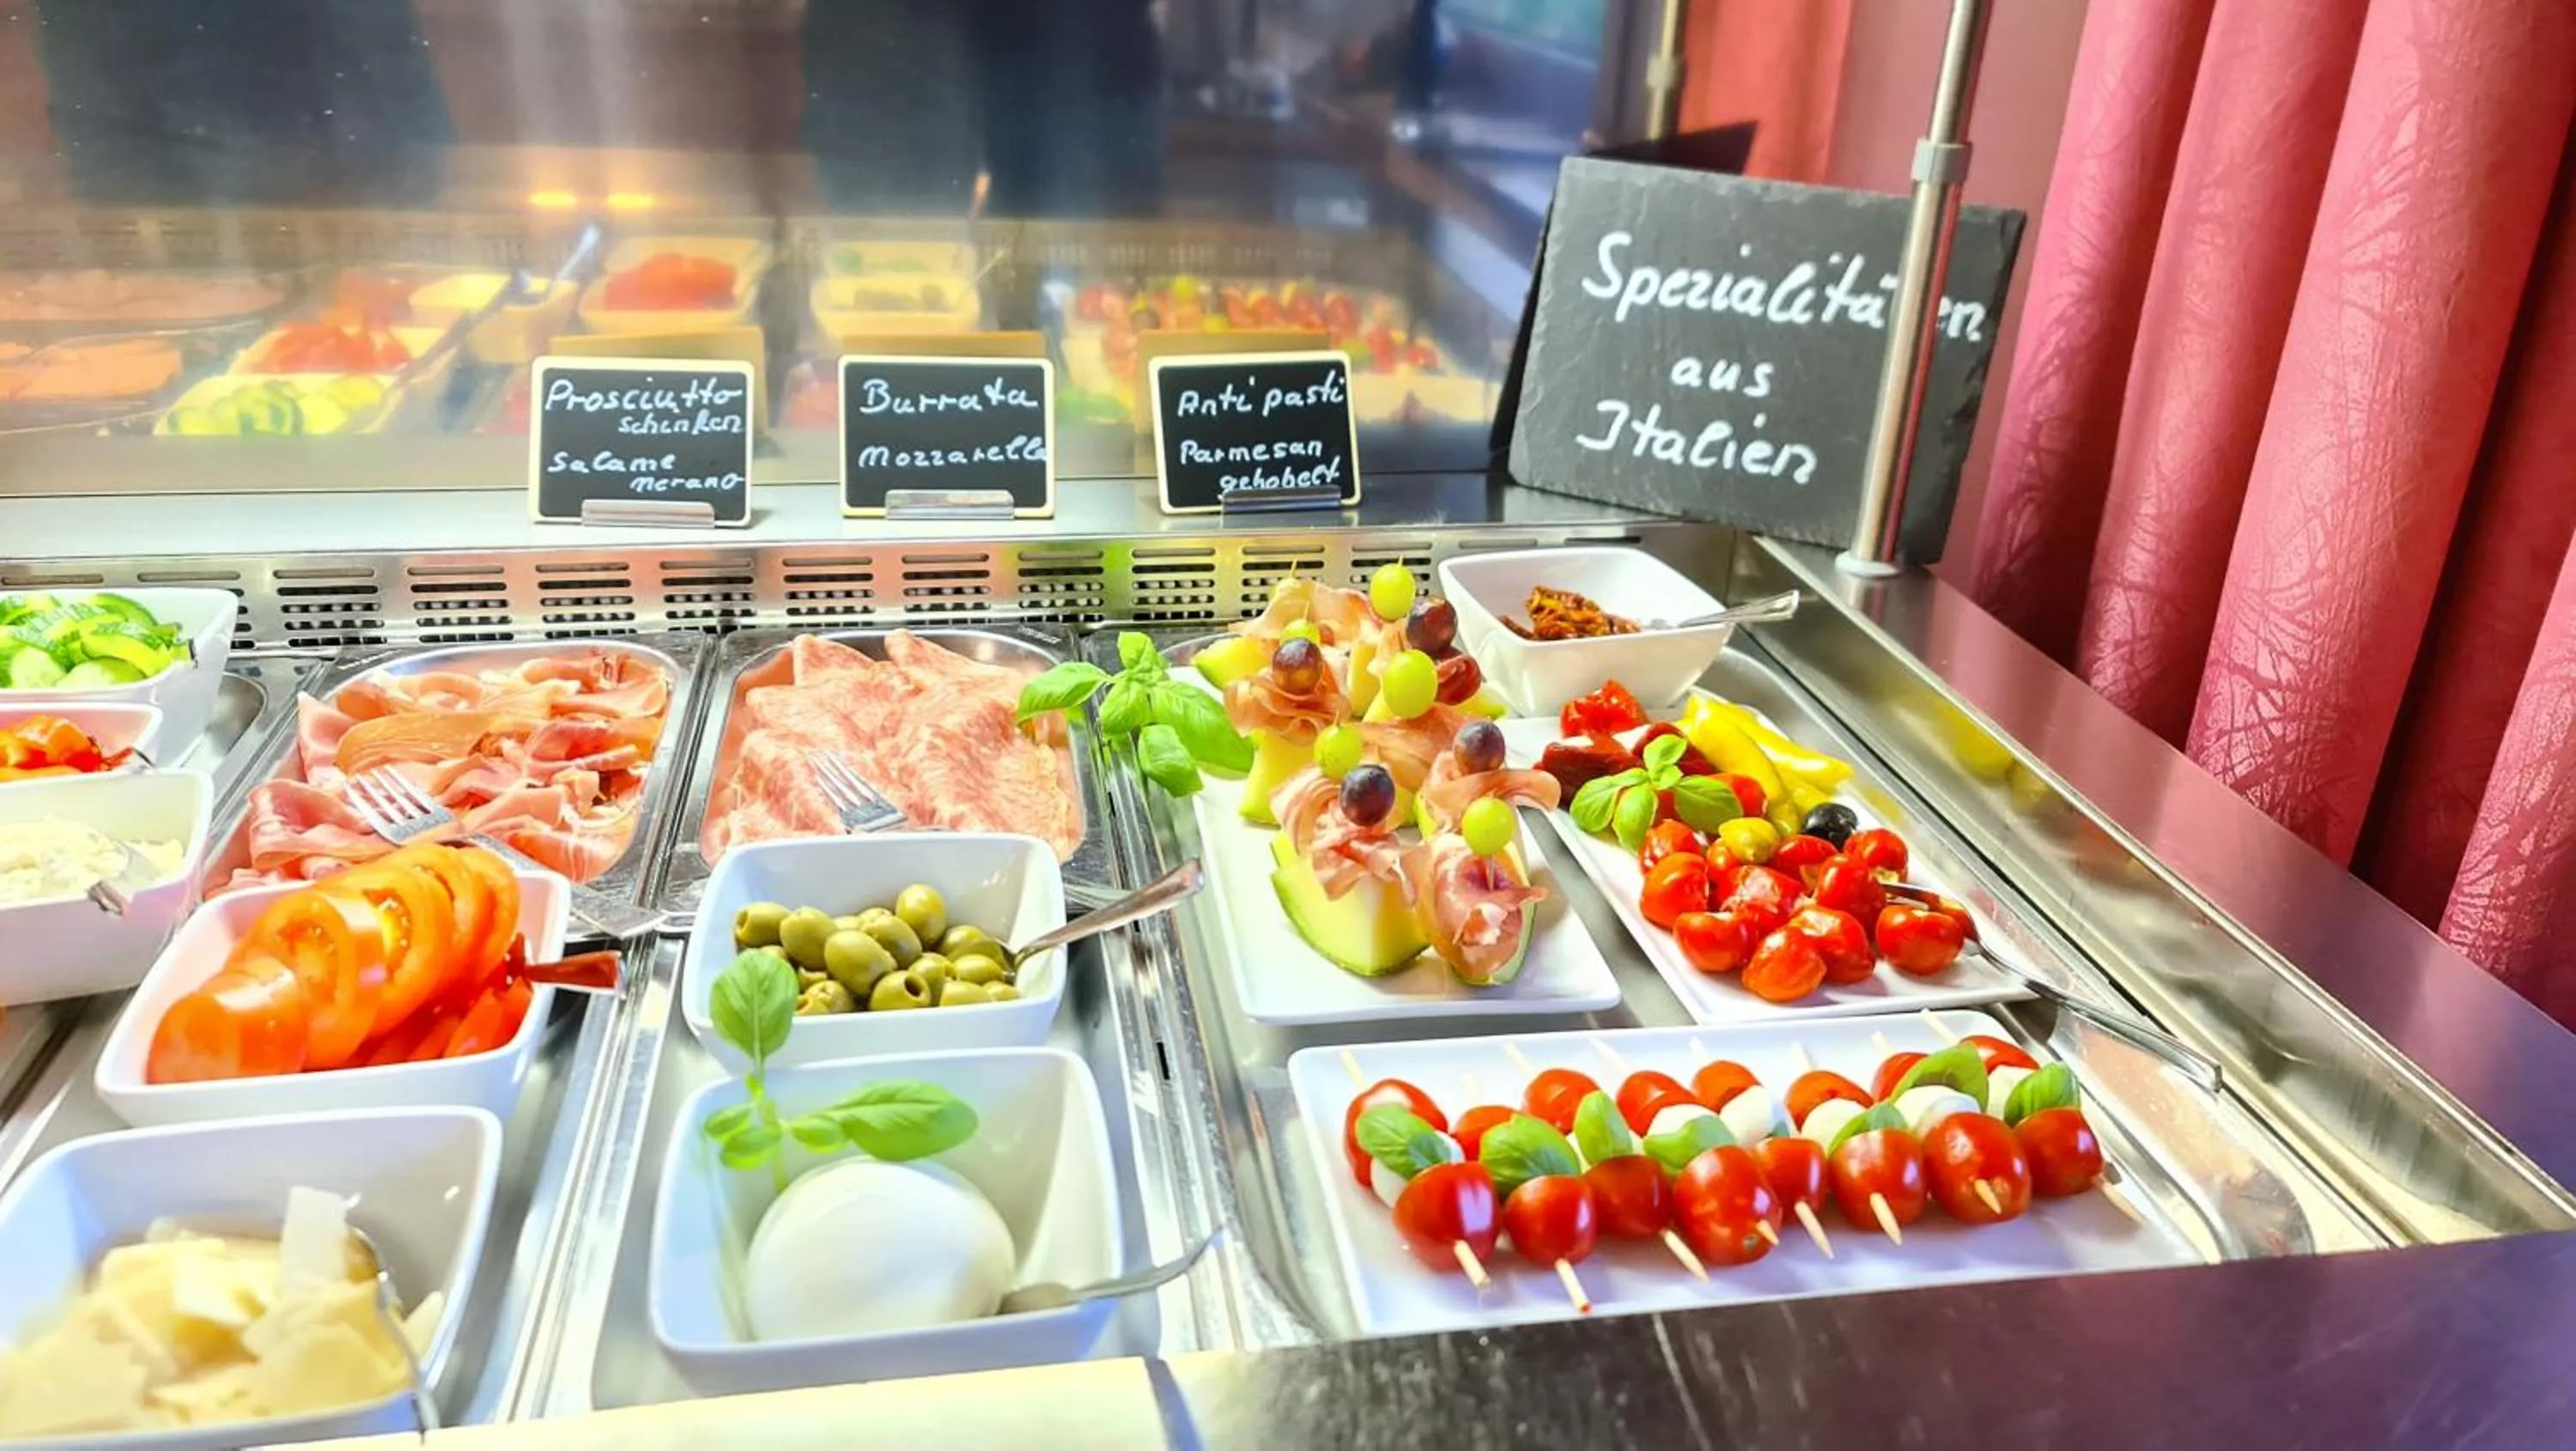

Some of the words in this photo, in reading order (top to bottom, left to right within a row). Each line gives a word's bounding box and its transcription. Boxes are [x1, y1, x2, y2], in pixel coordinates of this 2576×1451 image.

[1581, 231, 1986, 343] Spezialitän
[544, 377, 744, 413] Prosciutto
[859, 376, 1039, 415] Burrata
[1670, 355, 1775, 398] aus
[1180, 440, 1323, 464] Parmesan
[1575, 399, 1817, 484] Italien
